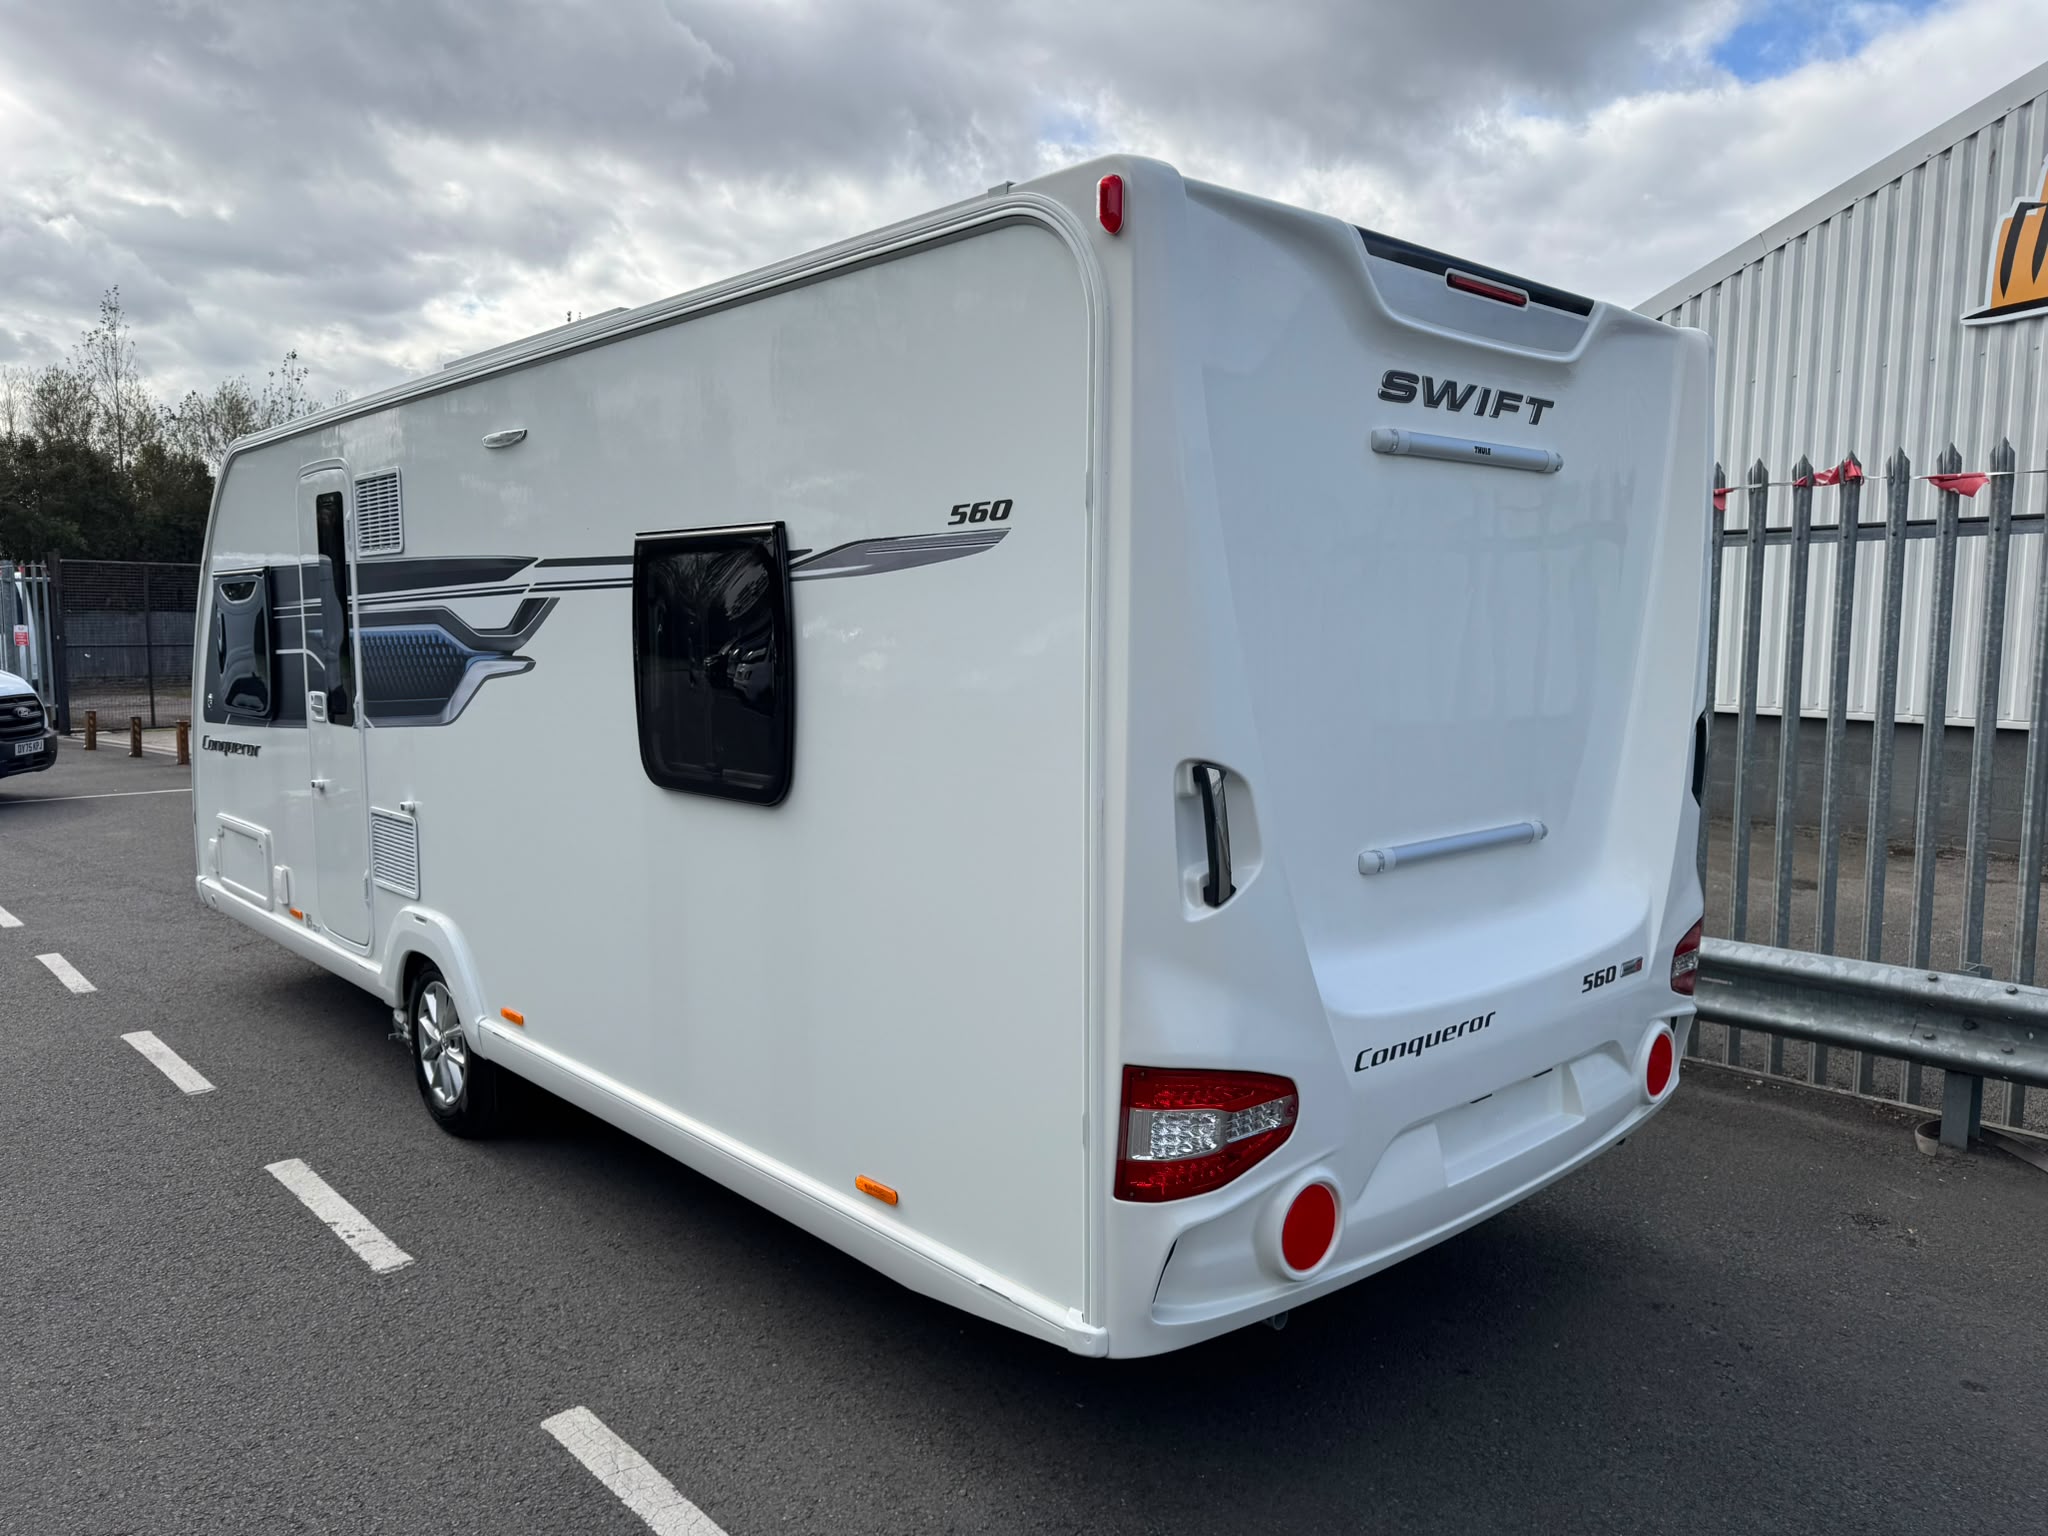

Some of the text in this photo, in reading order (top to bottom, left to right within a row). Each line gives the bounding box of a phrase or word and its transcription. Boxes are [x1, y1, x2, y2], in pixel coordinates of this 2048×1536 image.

[1378, 369, 1555, 425] SWIFT
[1474, 446, 1491, 455] THULE
[948, 499, 1013, 525] 560
[202, 735, 261, 757] Conqueror
[1582, 965, 1617, 993] 560
[1353, 1011, 1496, 1072] Conqueror
